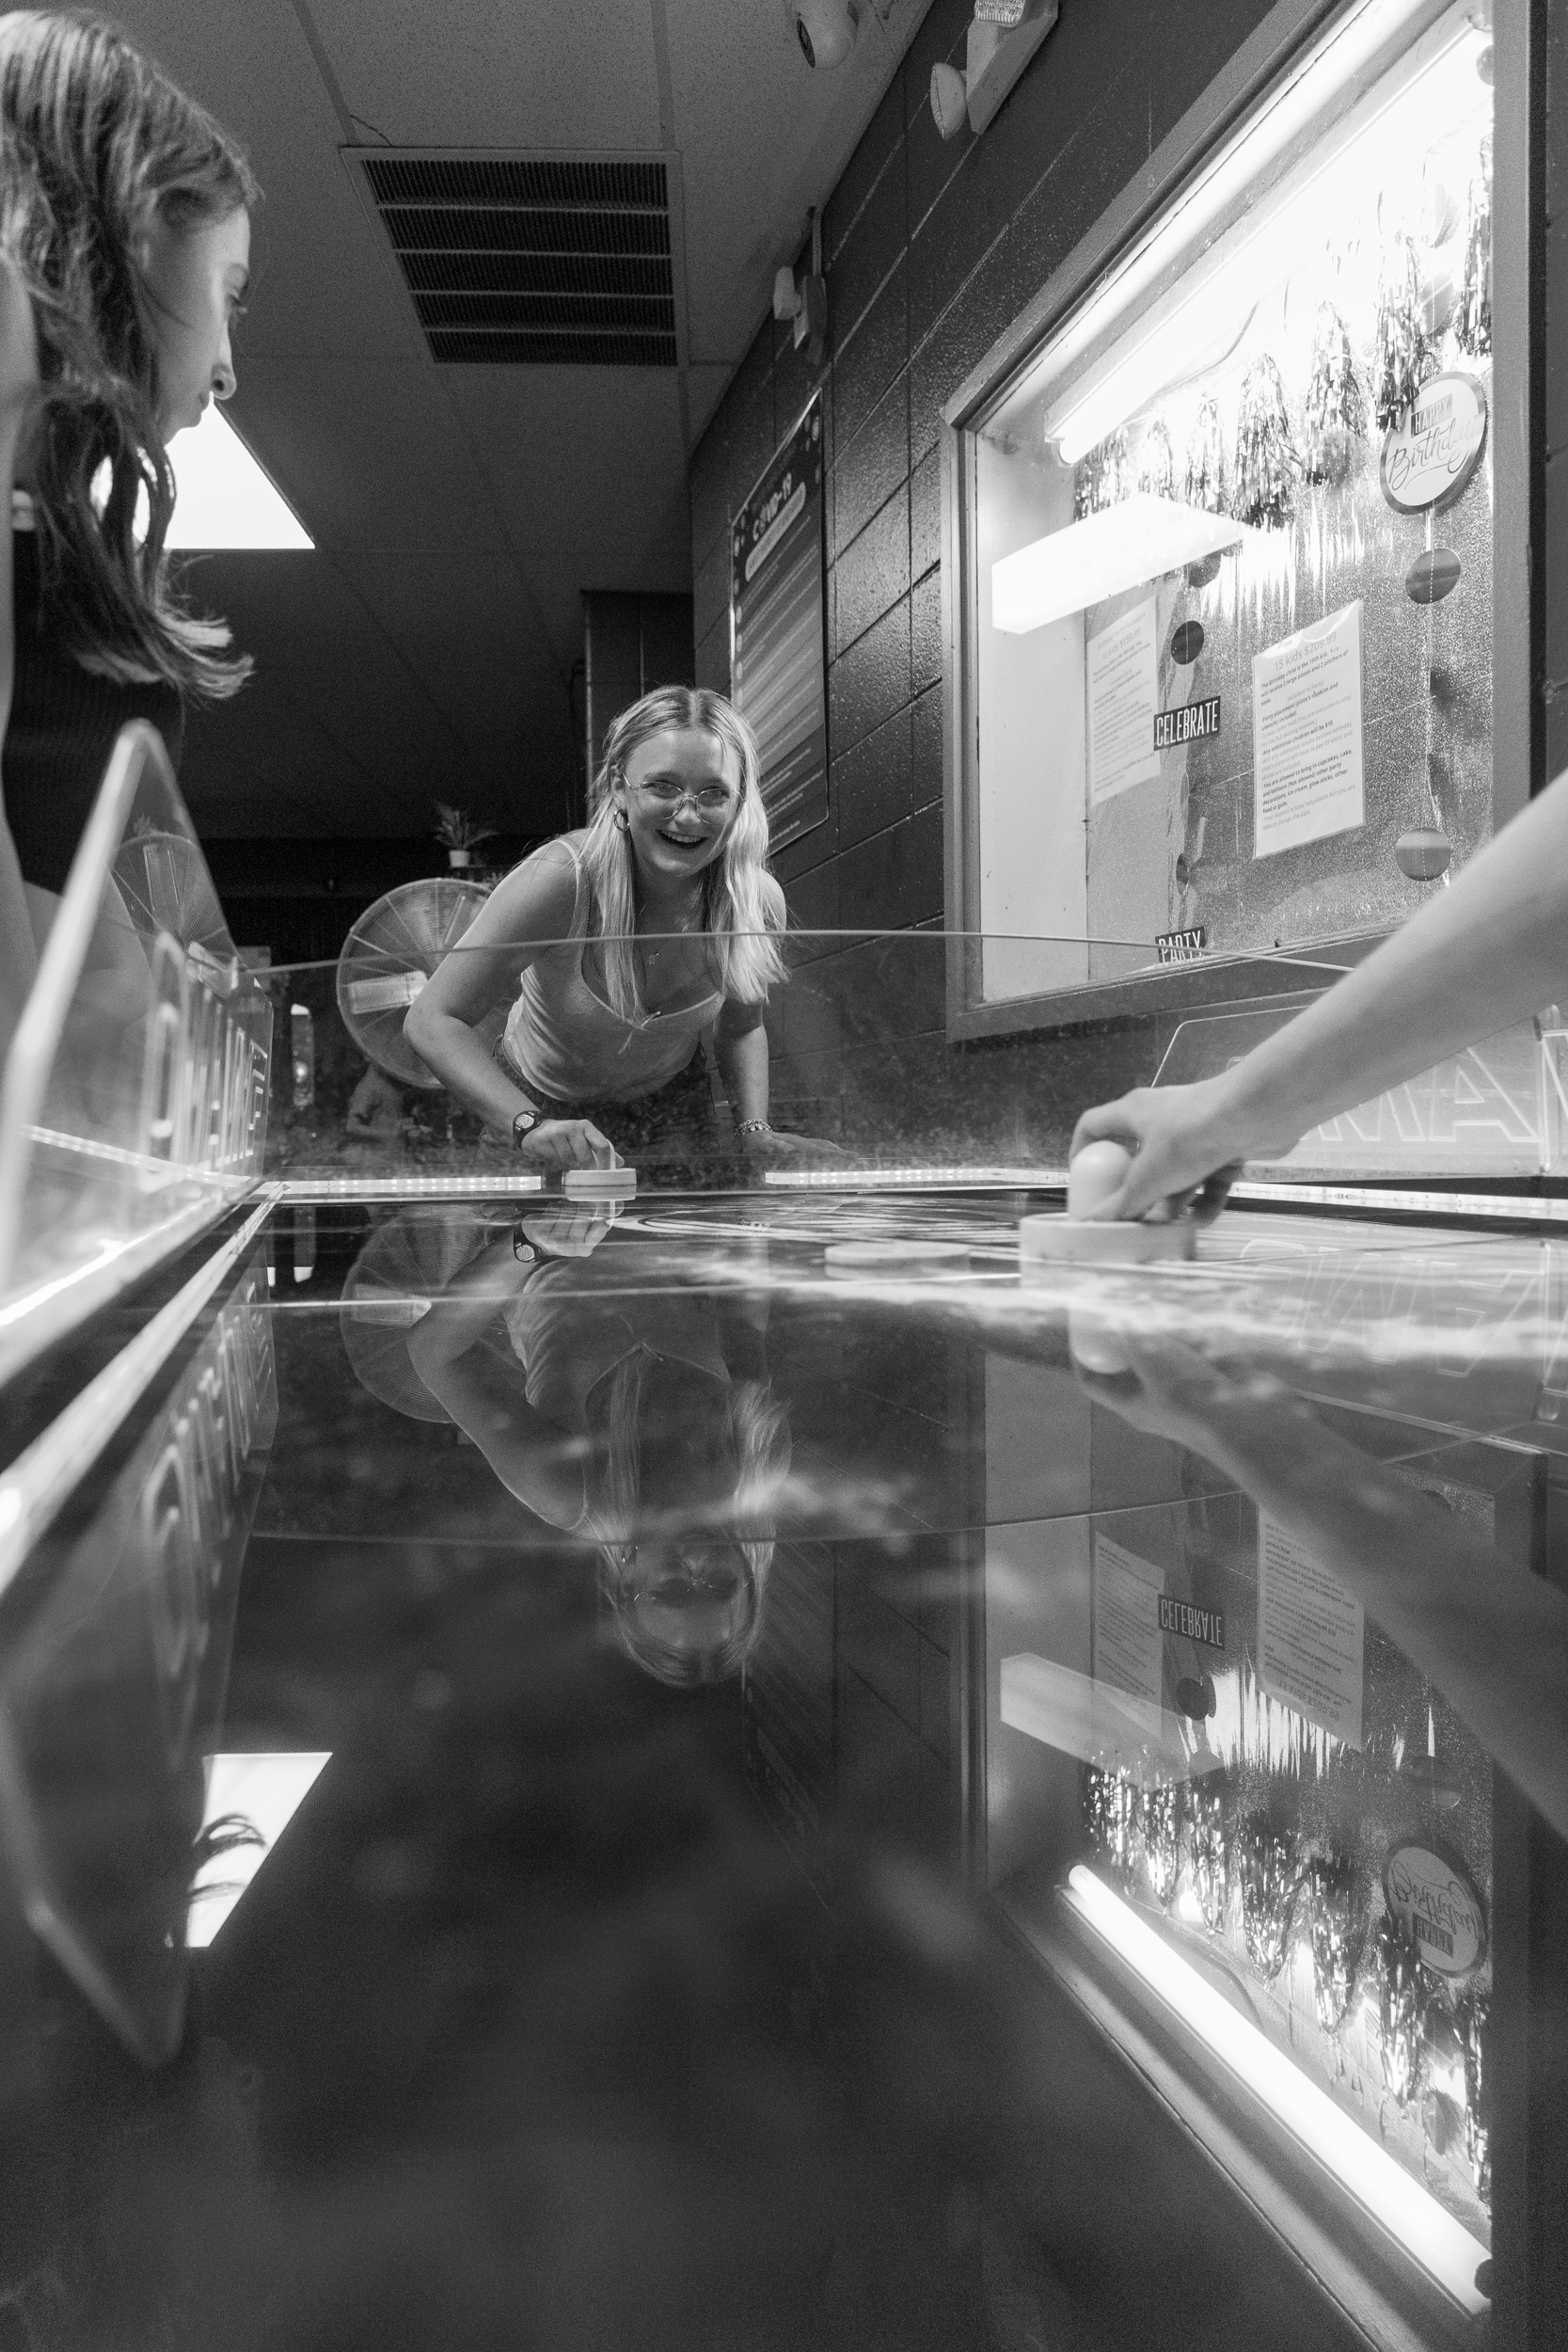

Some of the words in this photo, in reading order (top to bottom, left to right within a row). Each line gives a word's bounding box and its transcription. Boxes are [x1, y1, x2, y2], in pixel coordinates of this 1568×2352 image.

[1415, 396, 1449, 436] HAPPY
[1387, 415, 1478, 491] Birthday
[1275, 659, 1283, 671] 15
[1286, 650, 1302, 666] kids
[1304, 631, 1337, 656] $209.99
[1269, 684, 1283, 693] receive
[1298, 670, 1311, 680] pizzas
[1311, 664, 1320, 672] and
[1324, 654, 1342, 667] pitchers
[1269, 674, 1285, 685] Birthday
[1286, 667, 1296, 676] child
[1274, 703, 1295, 718] placement
[1312, 687, 1329, 698] napkins
[1156, 700, 1219, 747] CELEBRATE
[1272, 739, 1291, 752] additional
[1292, 732, 1309, 742] children
[1271, 784, 1287, 794] balloons
[1329, 763, 1342, 772] party
[1279, 772, 1294, 782] allowed
[1309, 781, 1319, 789] glow
[1158, 930, 1202, 963] PARTY
